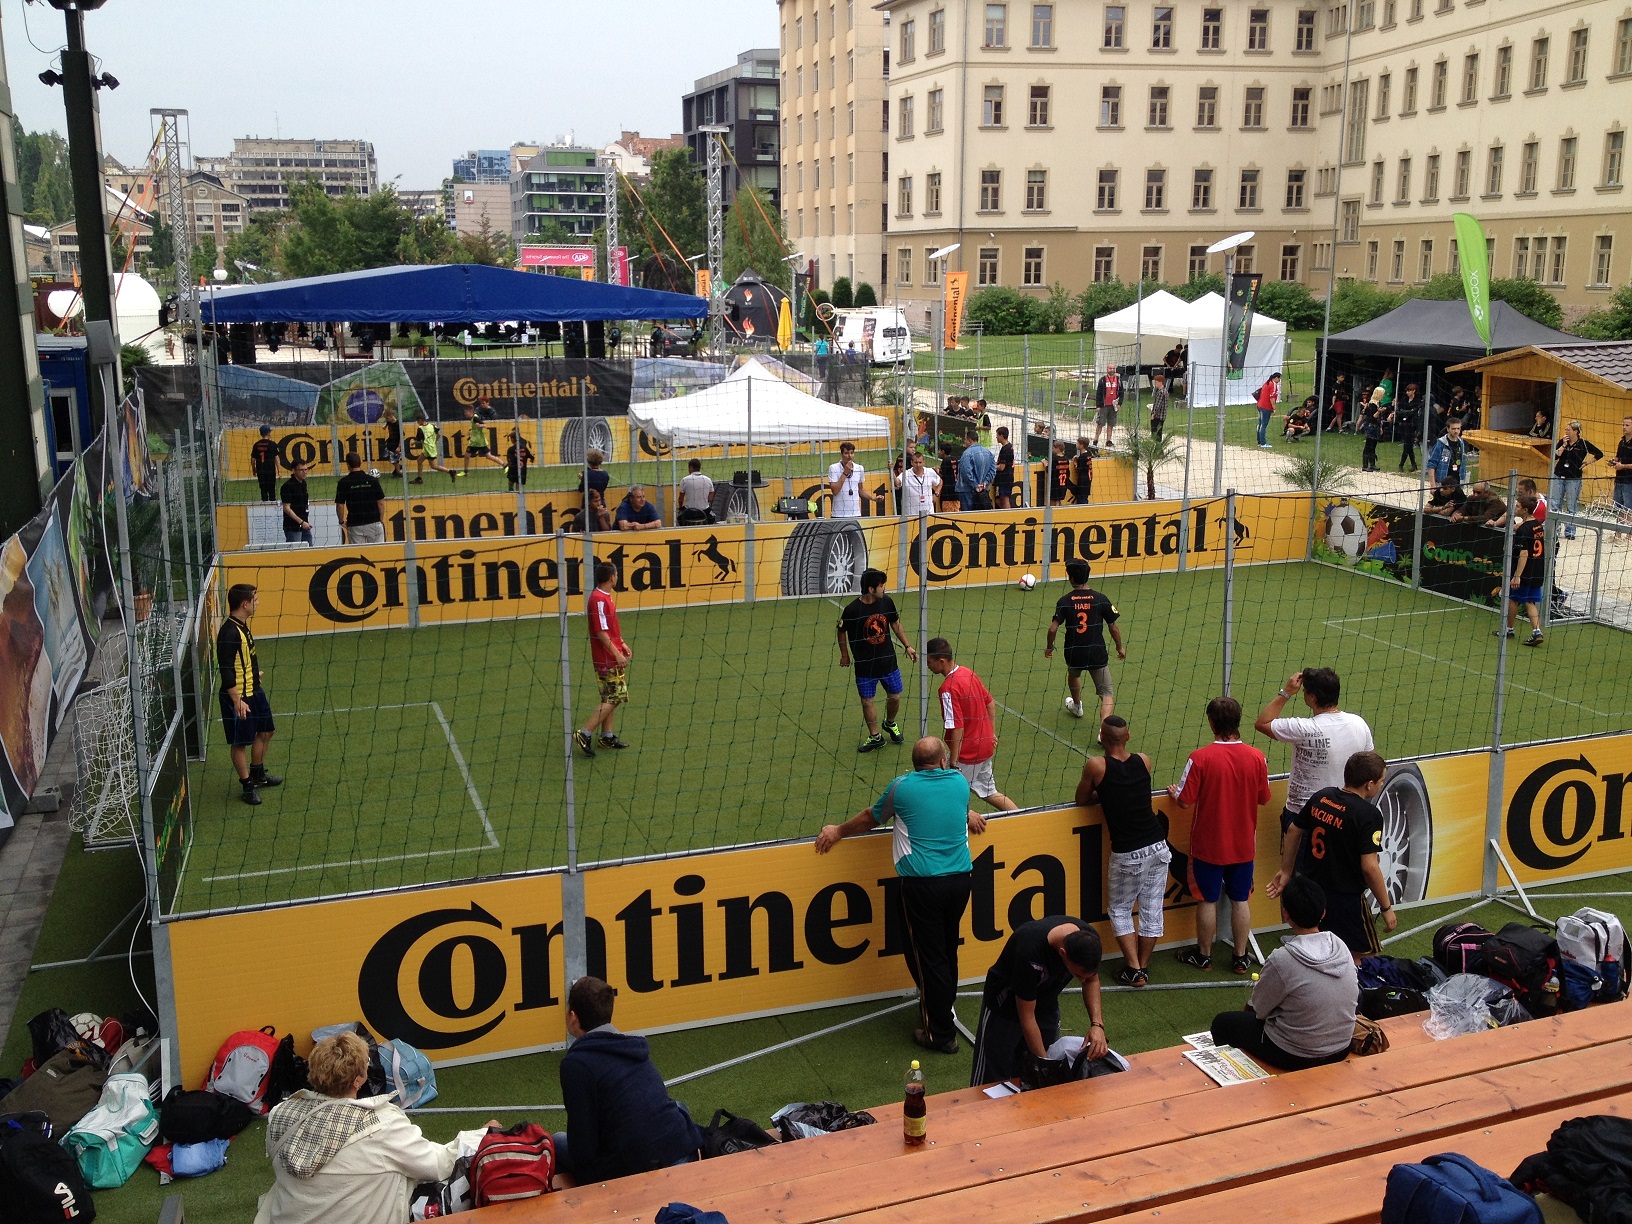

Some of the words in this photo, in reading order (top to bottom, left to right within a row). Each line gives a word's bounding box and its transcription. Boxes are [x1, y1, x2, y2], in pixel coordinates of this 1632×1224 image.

[1469, 270, 1480, 302] XBOX
[452, 377, 579, 405] Continental
[909, 507, 1208, 582] Continental
[1532, 540, 1543, 558] 9
[309, 539, 687, 623] Continental
[1076, 612, 1088, 634] 3
[1333, 817, 1343, 830] N.
[1311, 826, 1326, 859] 6
[54, 1182, 80, 1220] FILA
